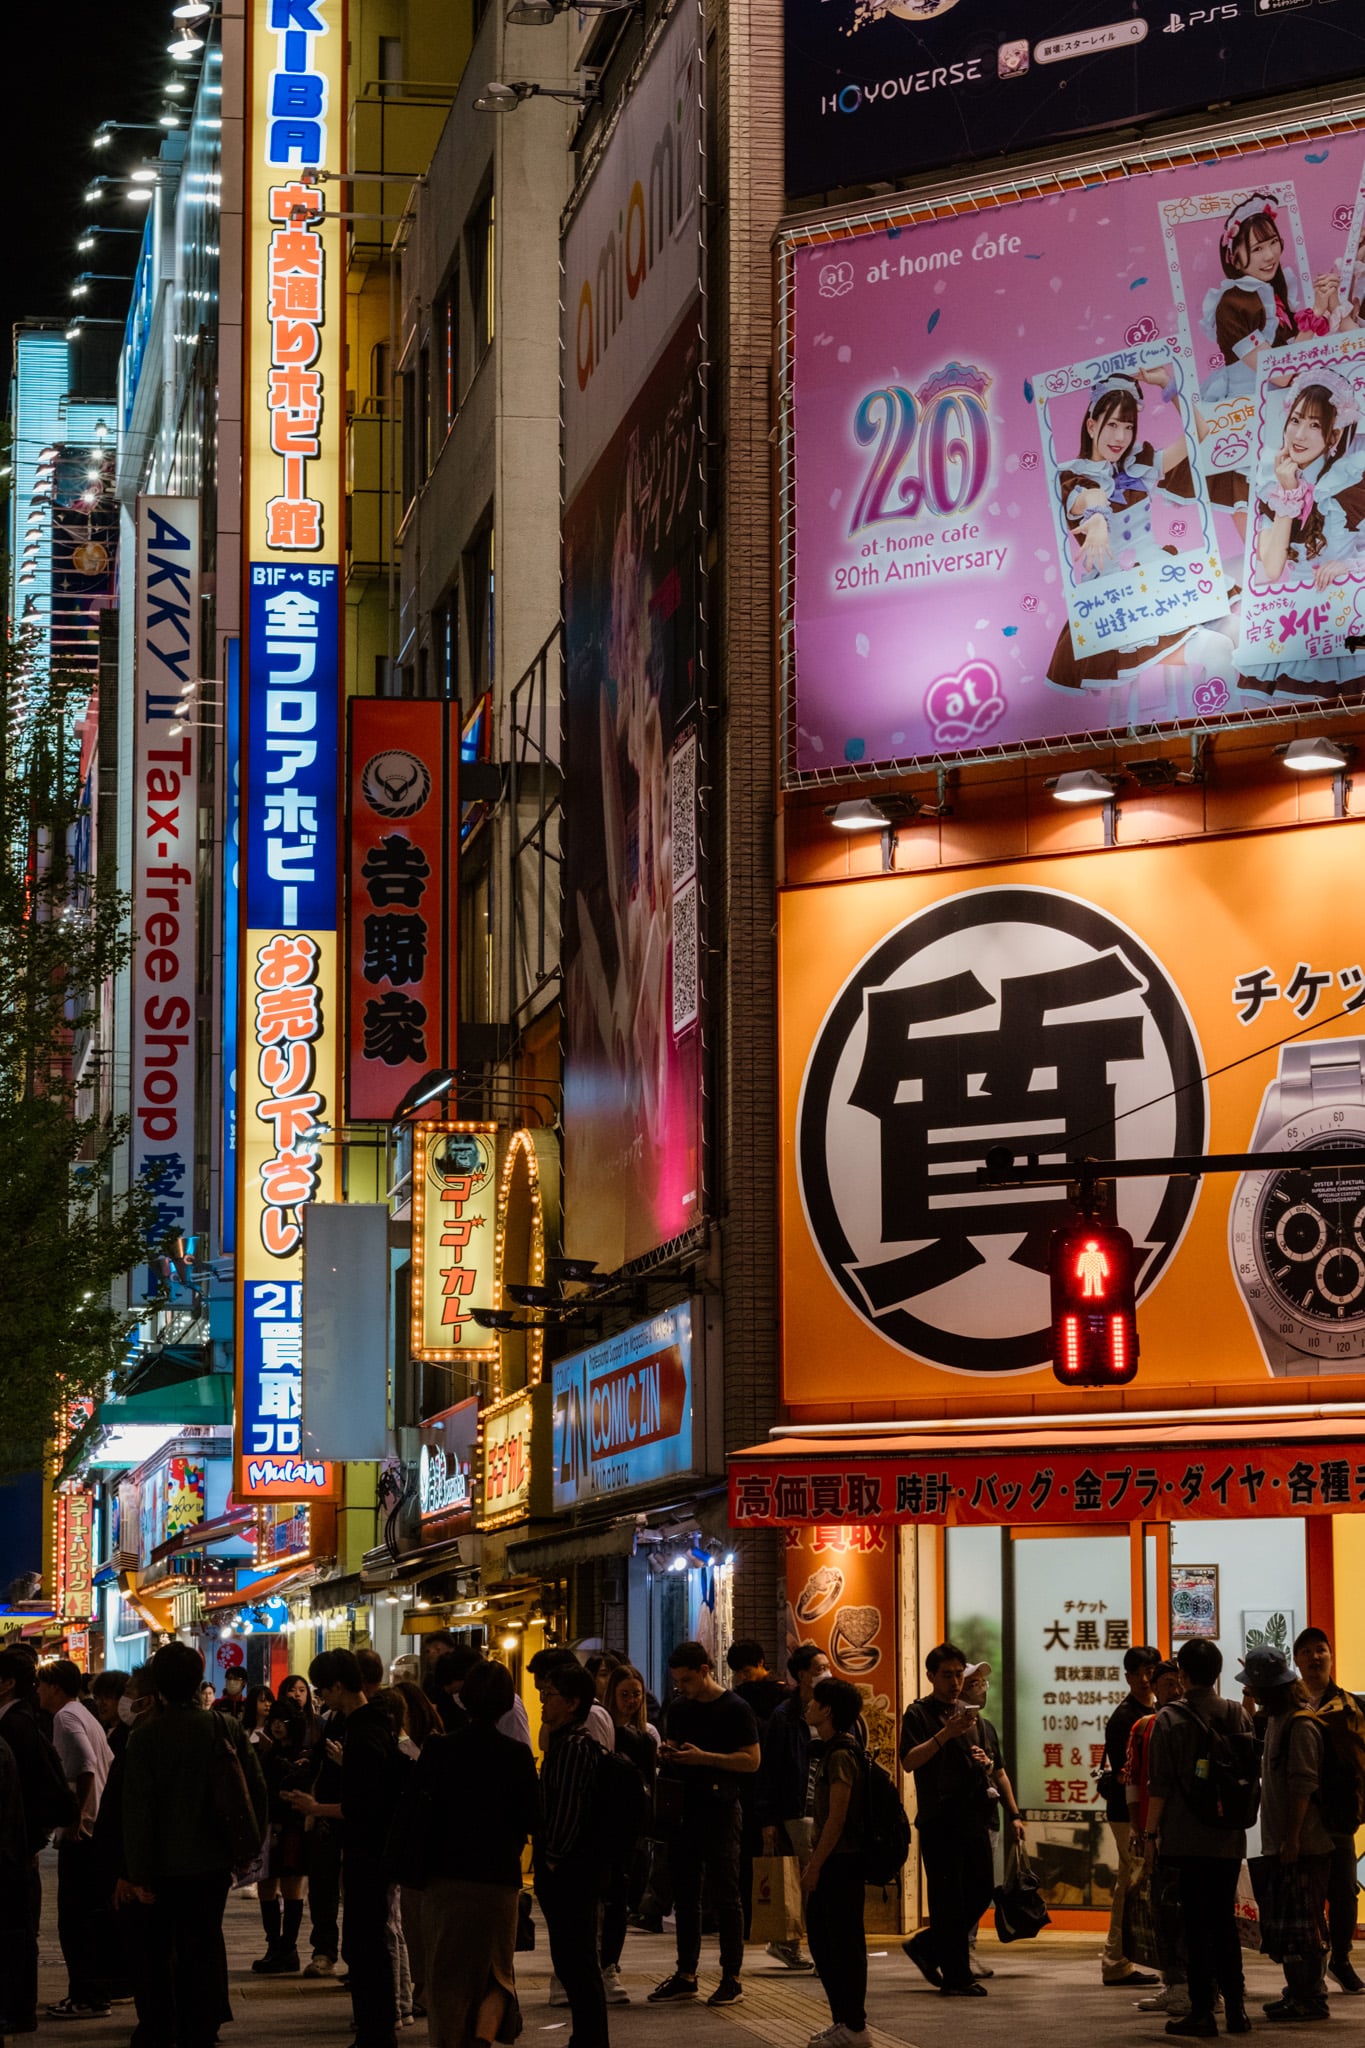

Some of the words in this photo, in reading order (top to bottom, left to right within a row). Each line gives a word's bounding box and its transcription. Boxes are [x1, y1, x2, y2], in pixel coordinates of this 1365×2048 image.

[1189, 4, 1239, 26] PS5
[821, 58, 982, 115] HOYOVERSE
[577, 98, 682, 391] amiami
[866, 249, 963, 284] at-home
[971, 234, 1022, 261] cafe
[269, 184, 324, 548] 中央通りホビー館
[848, 385, 991, 538] 20
[861, 530, 935, 557] at-home
[941, 523, 980, 543] cafe
[834, 563, 879, 590] 20th
[885, 547, 1008, 582] Anniversary
[147, 508, 191, 682] AKKY
[1074, 585, 1134, 618] みんなに
[264, 590, 319, 926] 全フロアホビー
[145, 737, 191, 982] Tax-free
[361, 833, 431, 1066] 吉野家
[137, 996, 191, 1141] Shop
[259, 936, 318, 1252] お売り下さい
[847, 947, 1162, 1317] 質
[1287, 1128, 1298, 1138] 65
[1333, 1112, 1344, 1122] 60
[1240, 1198, 1250, 1208] 75
[440, 1167, 487, 1344] ゴーゴーカレー
[1235, 1232, 1246, 1243] 80
[1240, 1264, 1250, 1274] 85
[1250, 1288, 1260, 1298] 90
[1279, 1324, 1294, 1334] 100
[1308, 1337, 1320, 1348] 110
[1336, 1342, 1351, 1352] 120
[591, 1372, 637, 1453] COMIC
[639, 1363, 661, 1438] ZIN
[736, 1472, 882, 1519] 高価買取
[1064, 1600, 1108, 1614] チケット
[1043, 1619, 1131, 1650] 大黒屋
[1055, 1666, 1120, 1682] 質秋葉原店
